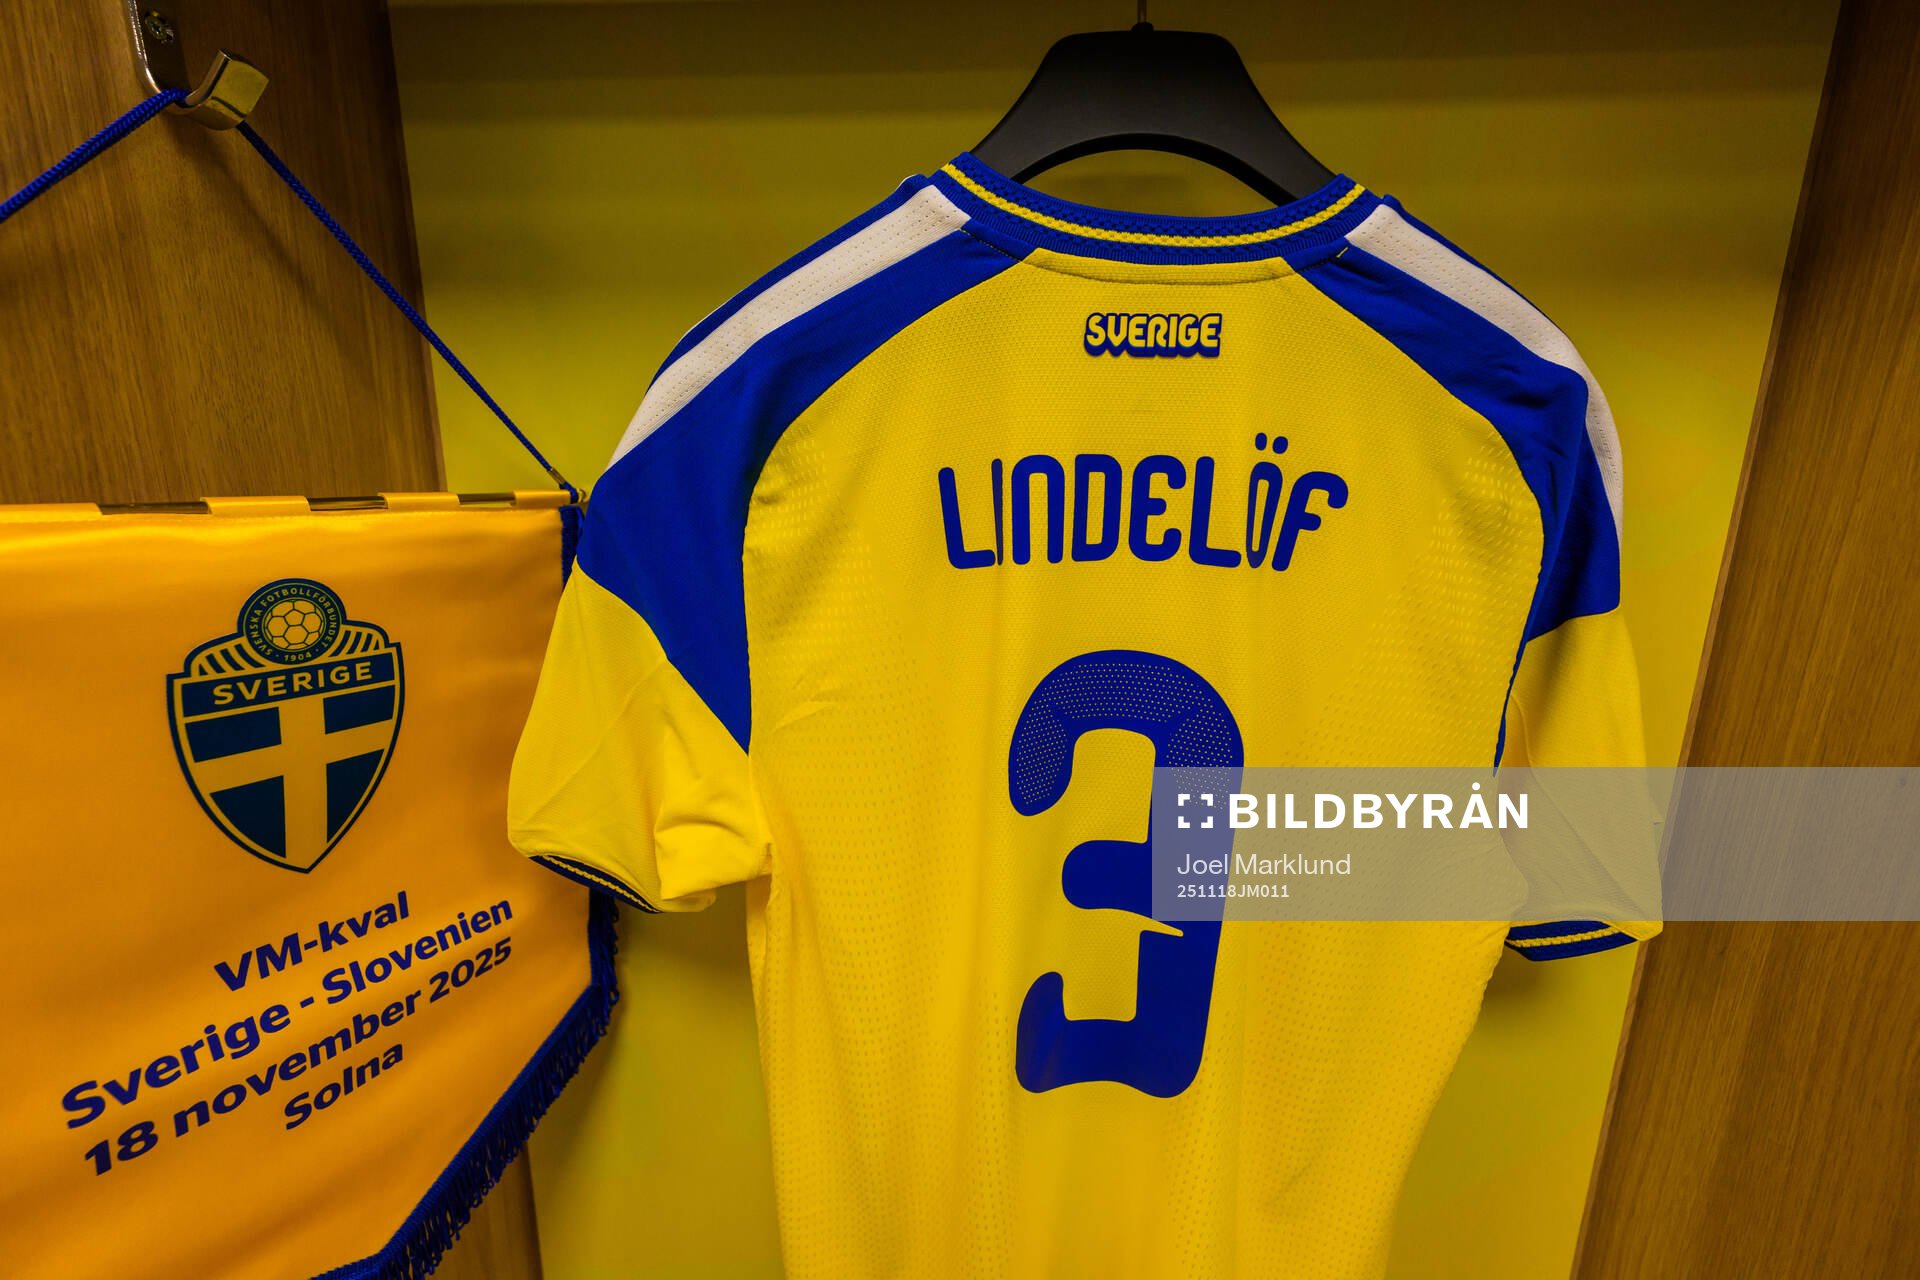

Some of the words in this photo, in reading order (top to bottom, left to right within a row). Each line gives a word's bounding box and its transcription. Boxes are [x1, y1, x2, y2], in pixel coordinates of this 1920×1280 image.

[1084, 312, 1222, 357] SVERIGE
[938, 432, 1349, 571] LINDELÖF
[249, 608, 273, 656] SVENSKA
[260, 586, 337, 650] FOTBOLLFÖRBUNDET
[283, 651, 313, 662] 1904
[212, 661, 373, 705] SVERIGE
[1008, 649, 1244, 1098] 3
[213, 890, 410, 992] VM-kval
[61, 1004, 291, 1129] Sverige
[321, 899, 513, 1005] Slovenien
[83, 1119, 159, 1177] 18
[173, 990, 424, 1138] november
[428, 936, 512, 1004] 2025
[284, 1043, 404, 1131] Solna
